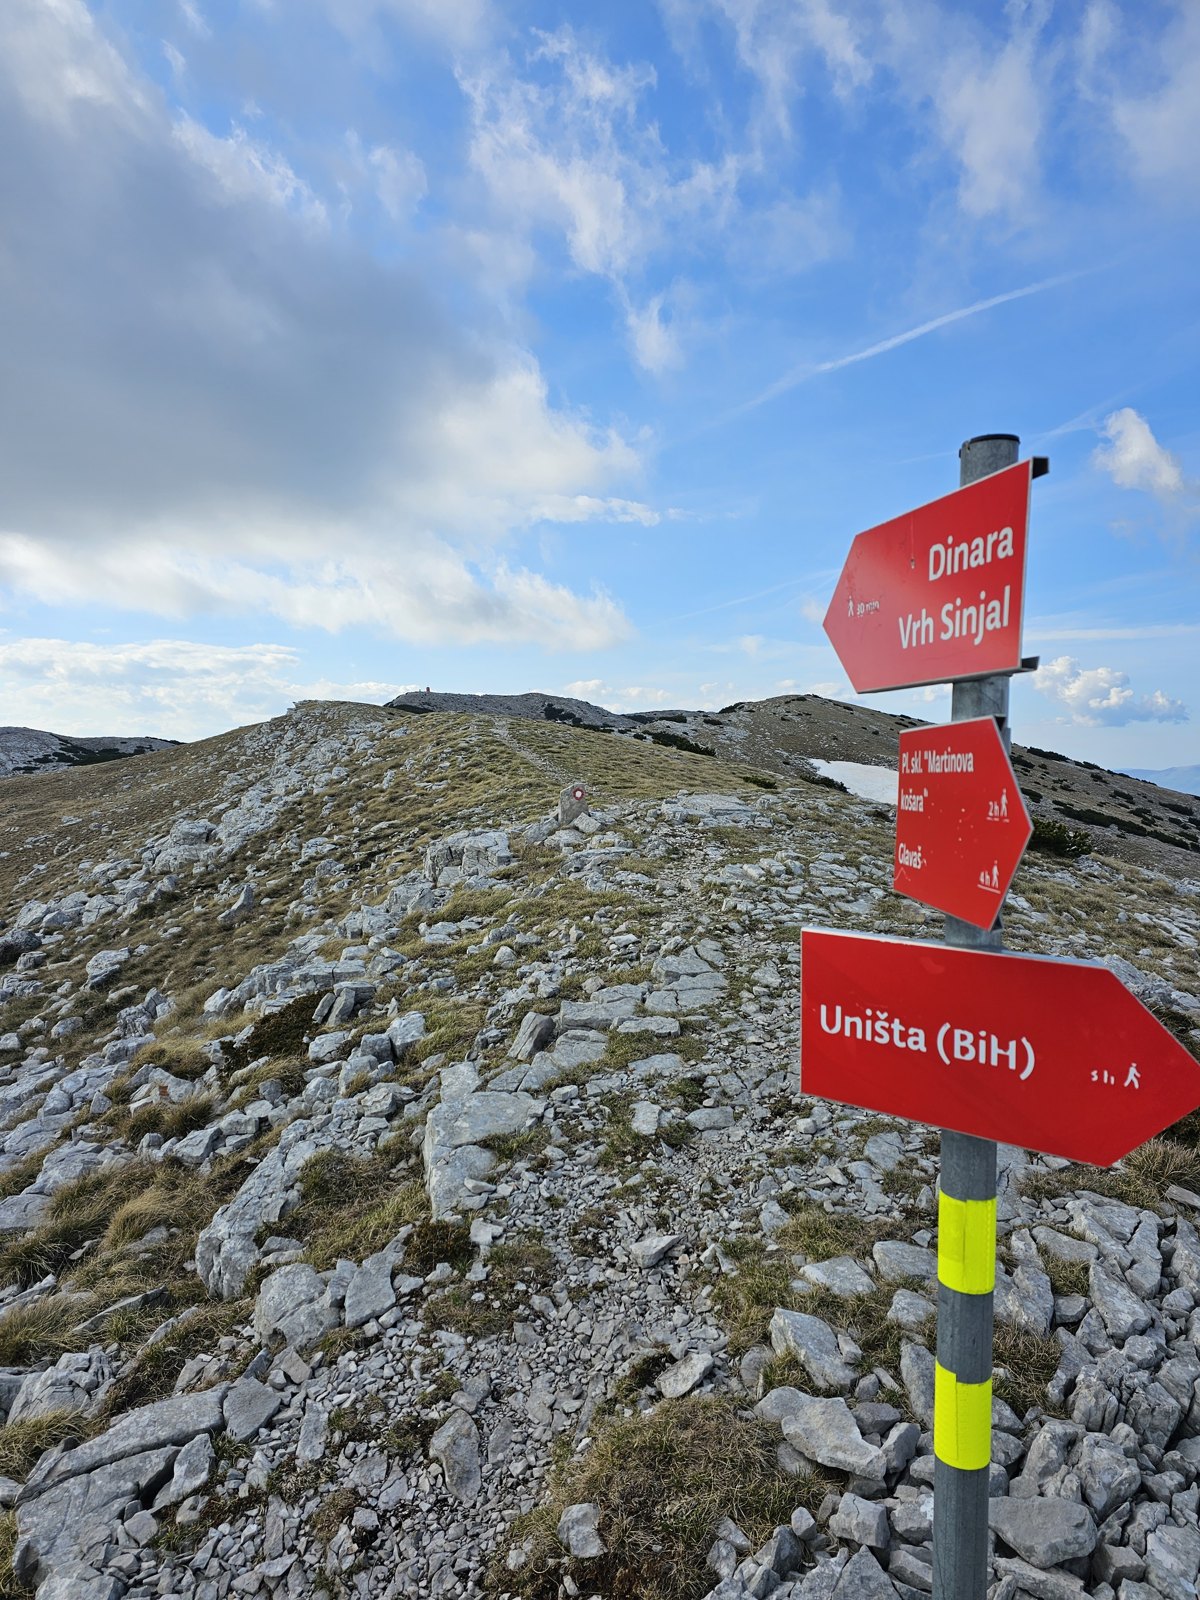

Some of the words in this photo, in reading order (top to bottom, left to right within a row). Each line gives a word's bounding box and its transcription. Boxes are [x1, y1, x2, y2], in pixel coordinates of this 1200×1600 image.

[928, 526, 1014, 582] Dinara
[898, 608, 934, 649] Vrh
[940, 585, 1011, 646] Sinjal
[898, 842, 922, 869] Glavaš
[820, 1004, 927, 1053] Uništa
[936, 1022, 1036, 1081] (BiH)
